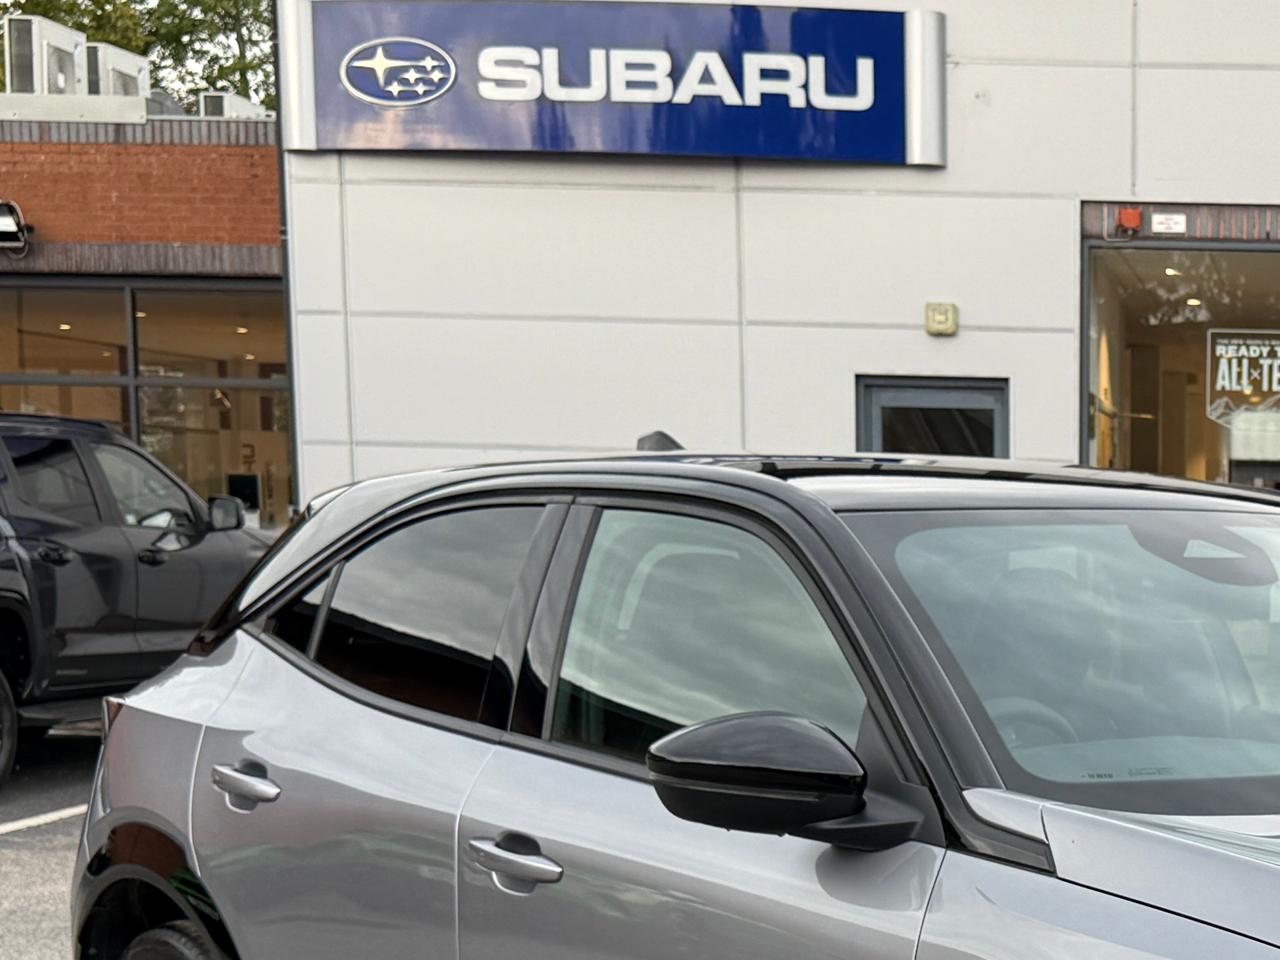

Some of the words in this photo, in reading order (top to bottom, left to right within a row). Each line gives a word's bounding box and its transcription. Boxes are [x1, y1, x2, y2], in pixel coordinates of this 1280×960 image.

[478, 46, 874, 111] SUBARU
[1215, 345, 1271, 358] READY
[1215, 358, 1253, 391] ALL
